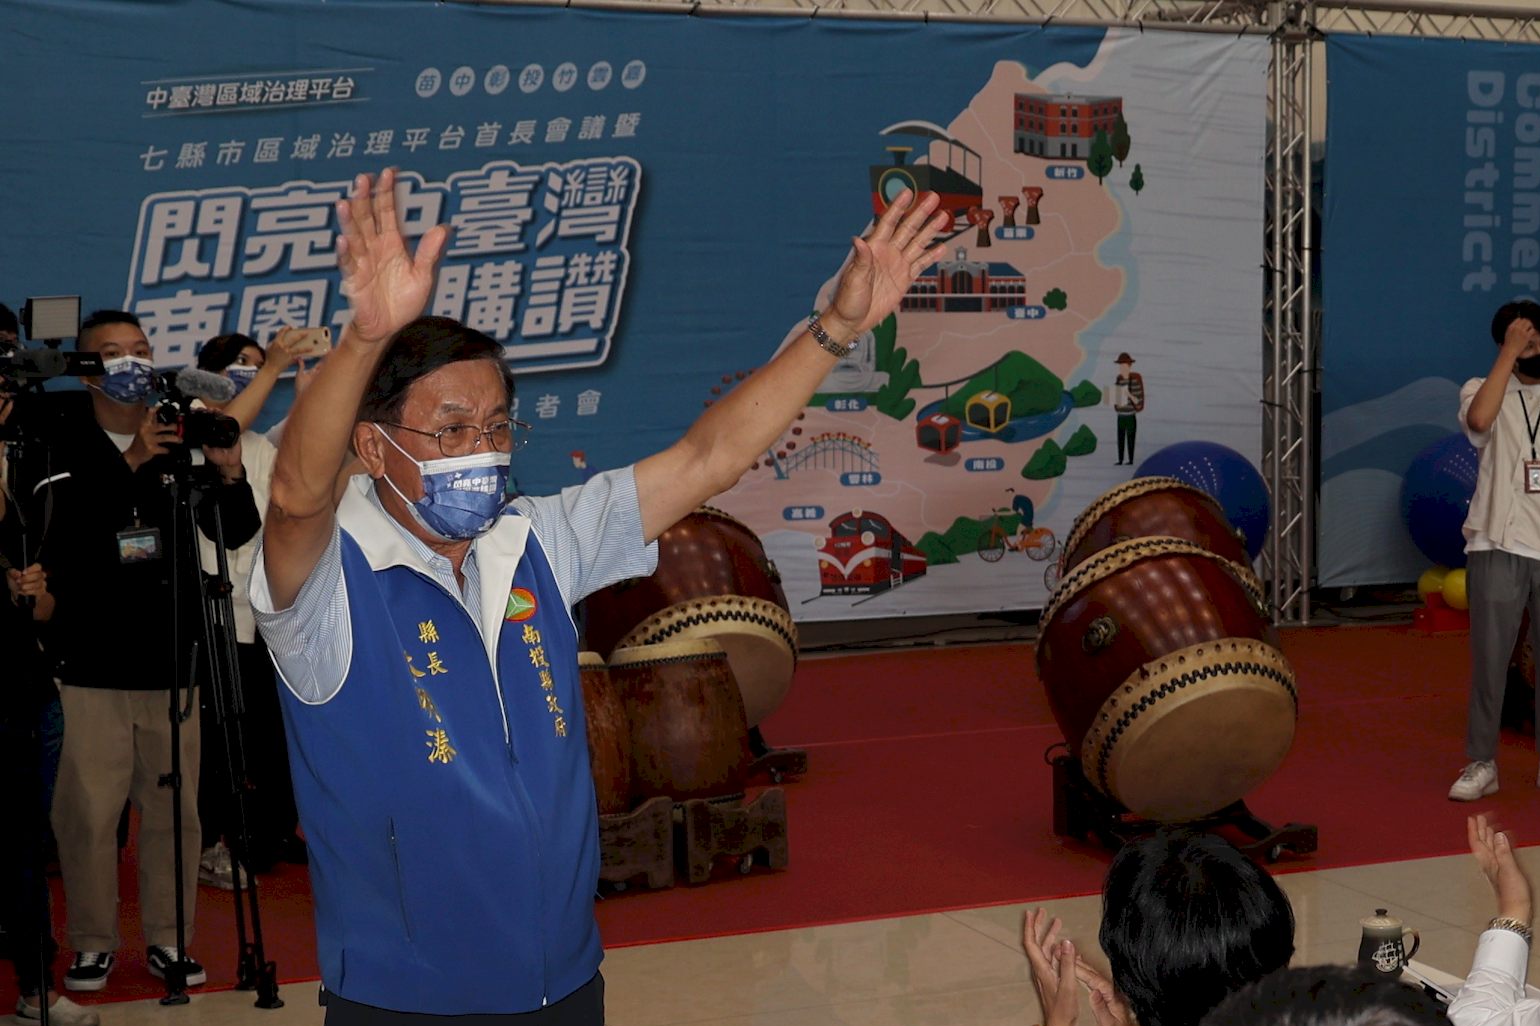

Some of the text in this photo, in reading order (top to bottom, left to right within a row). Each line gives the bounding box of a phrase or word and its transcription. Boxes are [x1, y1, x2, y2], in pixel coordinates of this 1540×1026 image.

[146, 77, 355, 110] 中臺灣區域治理平台
[140, 112, 641, 171] 七縣市區域治理平台首長會議暨
[1462, 70, 1506, 293] District
[418, 619, 448, 676] 縣長
[521, 623, 568, 737] 南投縣政府
